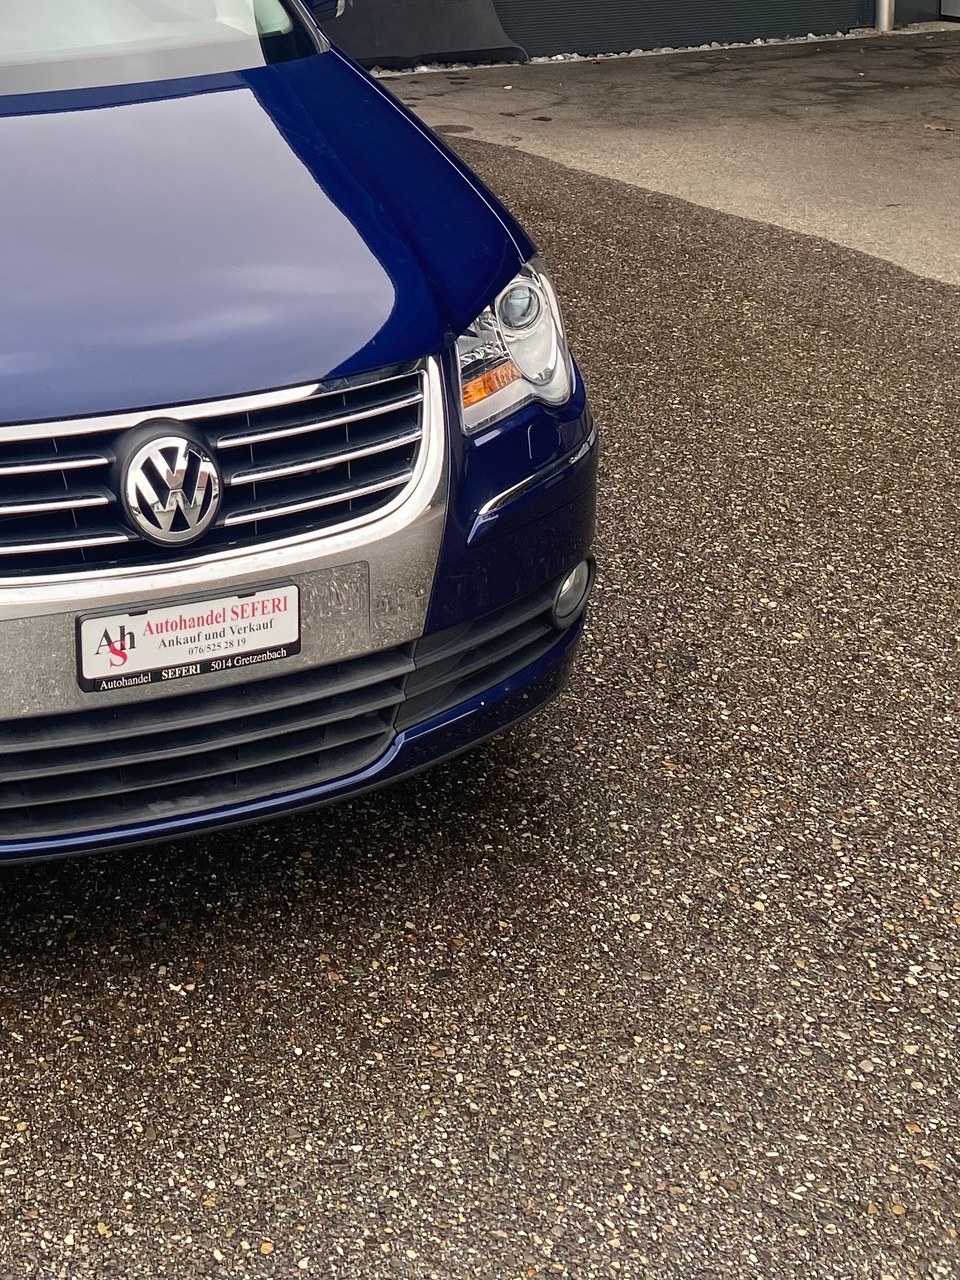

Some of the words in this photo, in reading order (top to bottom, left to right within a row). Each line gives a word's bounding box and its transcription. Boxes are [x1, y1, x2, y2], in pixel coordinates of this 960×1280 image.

[133, 442, 214, 535] VW
[143, 608, 226, 637] Autohandel
[230, 596, 288, 622] SEFERI
[158, 632, 202, 650] Ankauf
[204, 628, 226, 641] und
[229, 618, 275, 635] Verkauf
[188, 644, 222, 656] 076/525
[223, 641, 235, 649] 28
[237, 638, 246, 647] 19
[100, 673, 152, 691] Autohandel
[162, 664, 201, 679] SEFERI
[211, 658, 232, 671] 5014
[234, 648, 286, 666] Gretzenbach
